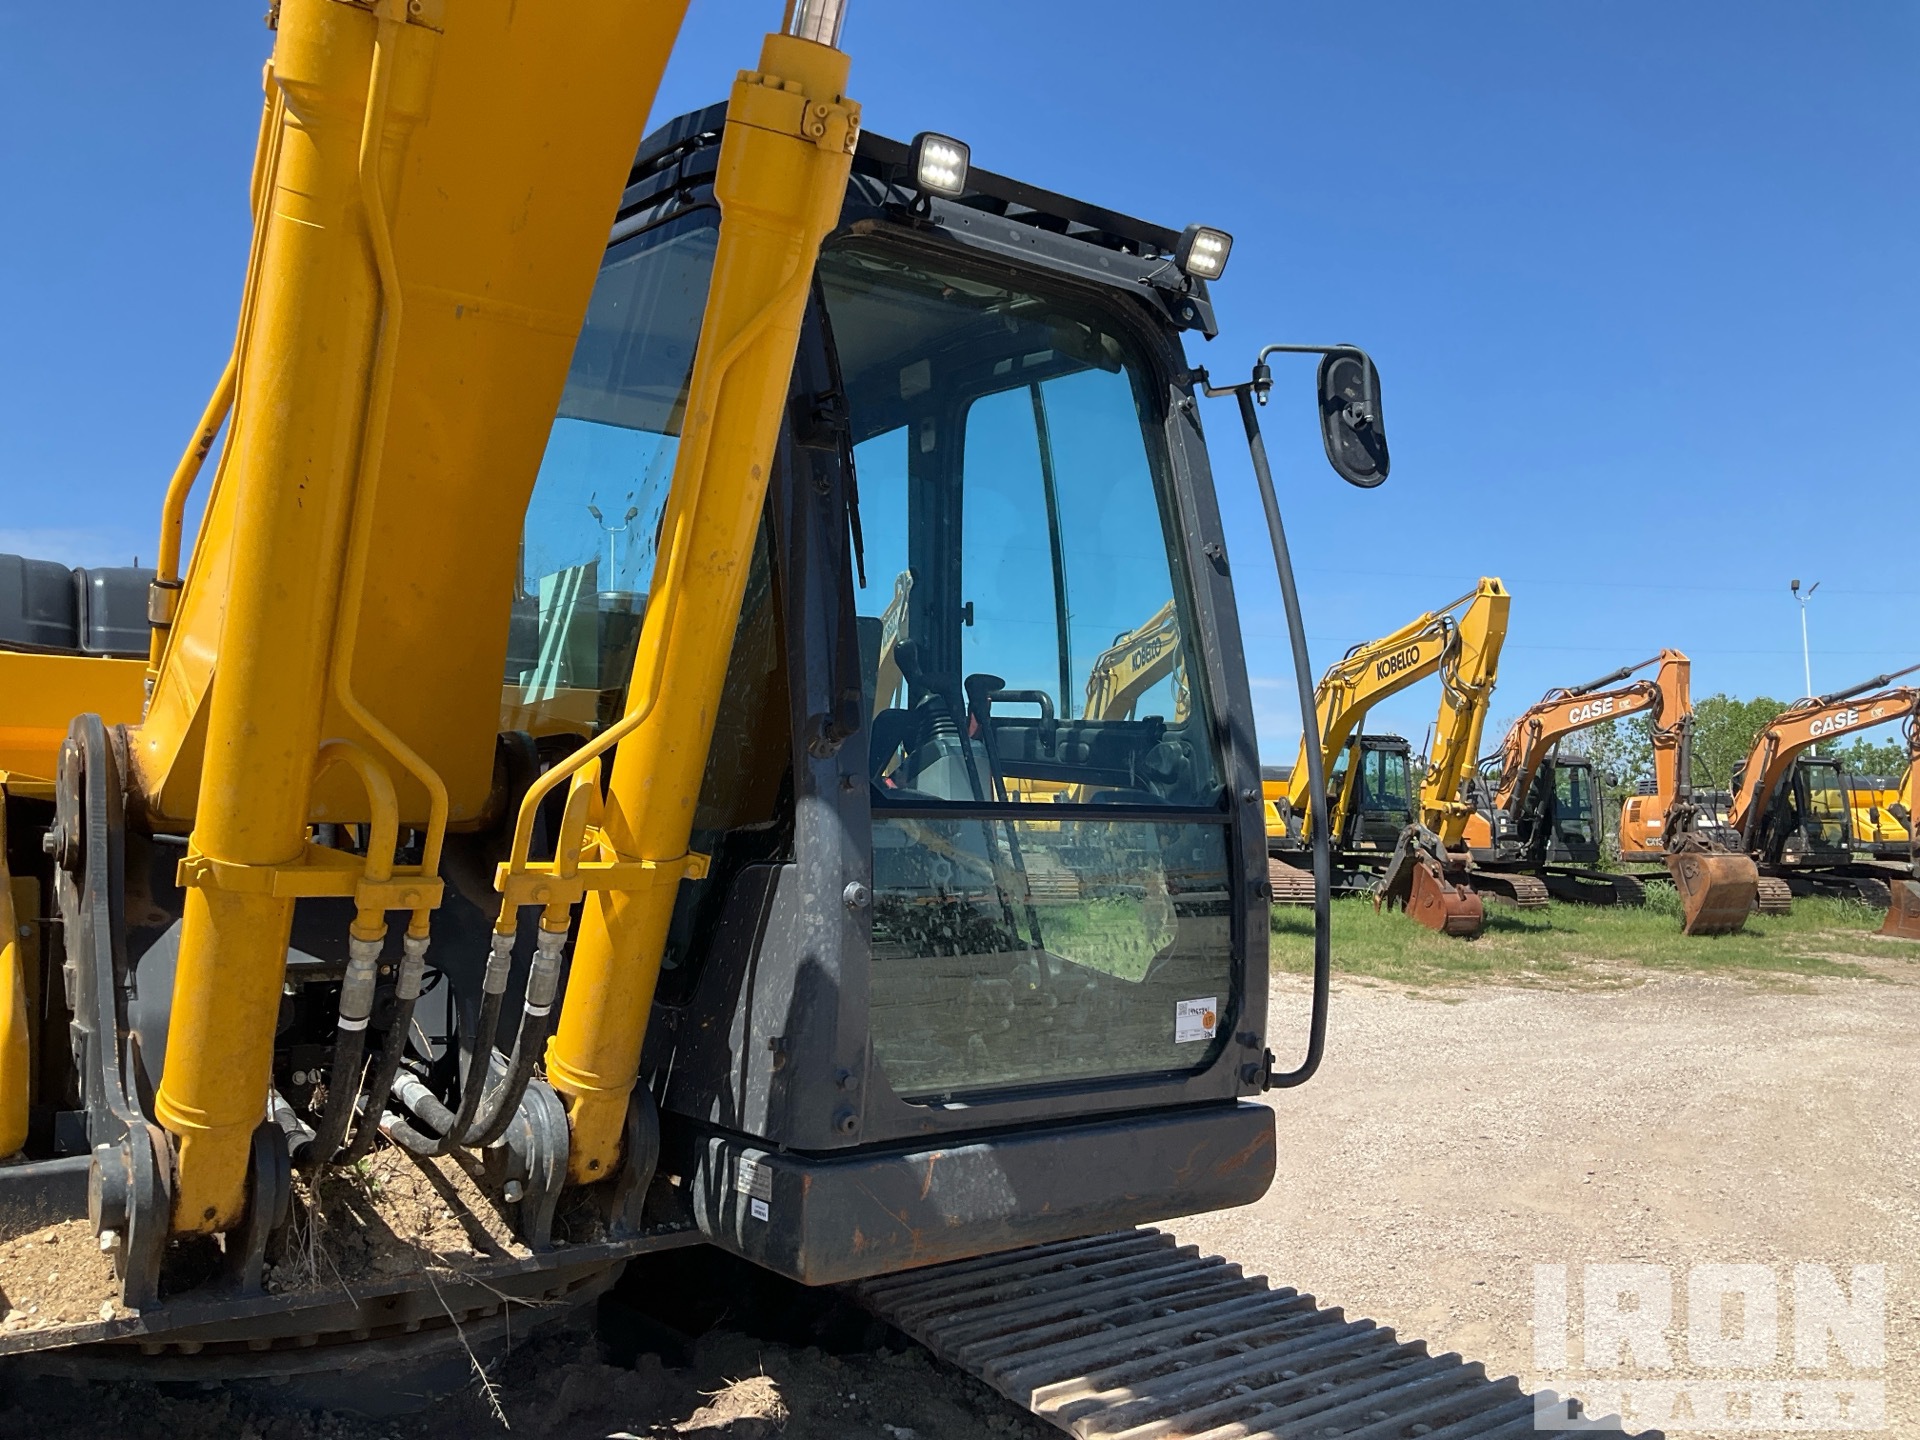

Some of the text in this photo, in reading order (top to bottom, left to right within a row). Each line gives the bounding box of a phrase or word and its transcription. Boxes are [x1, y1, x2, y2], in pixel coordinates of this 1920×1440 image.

[1377, 645, 1420, 681] KOBELCO
[1569, 697, 1613, 724] CASE
[1809, 707, 1859, 736] CASE
